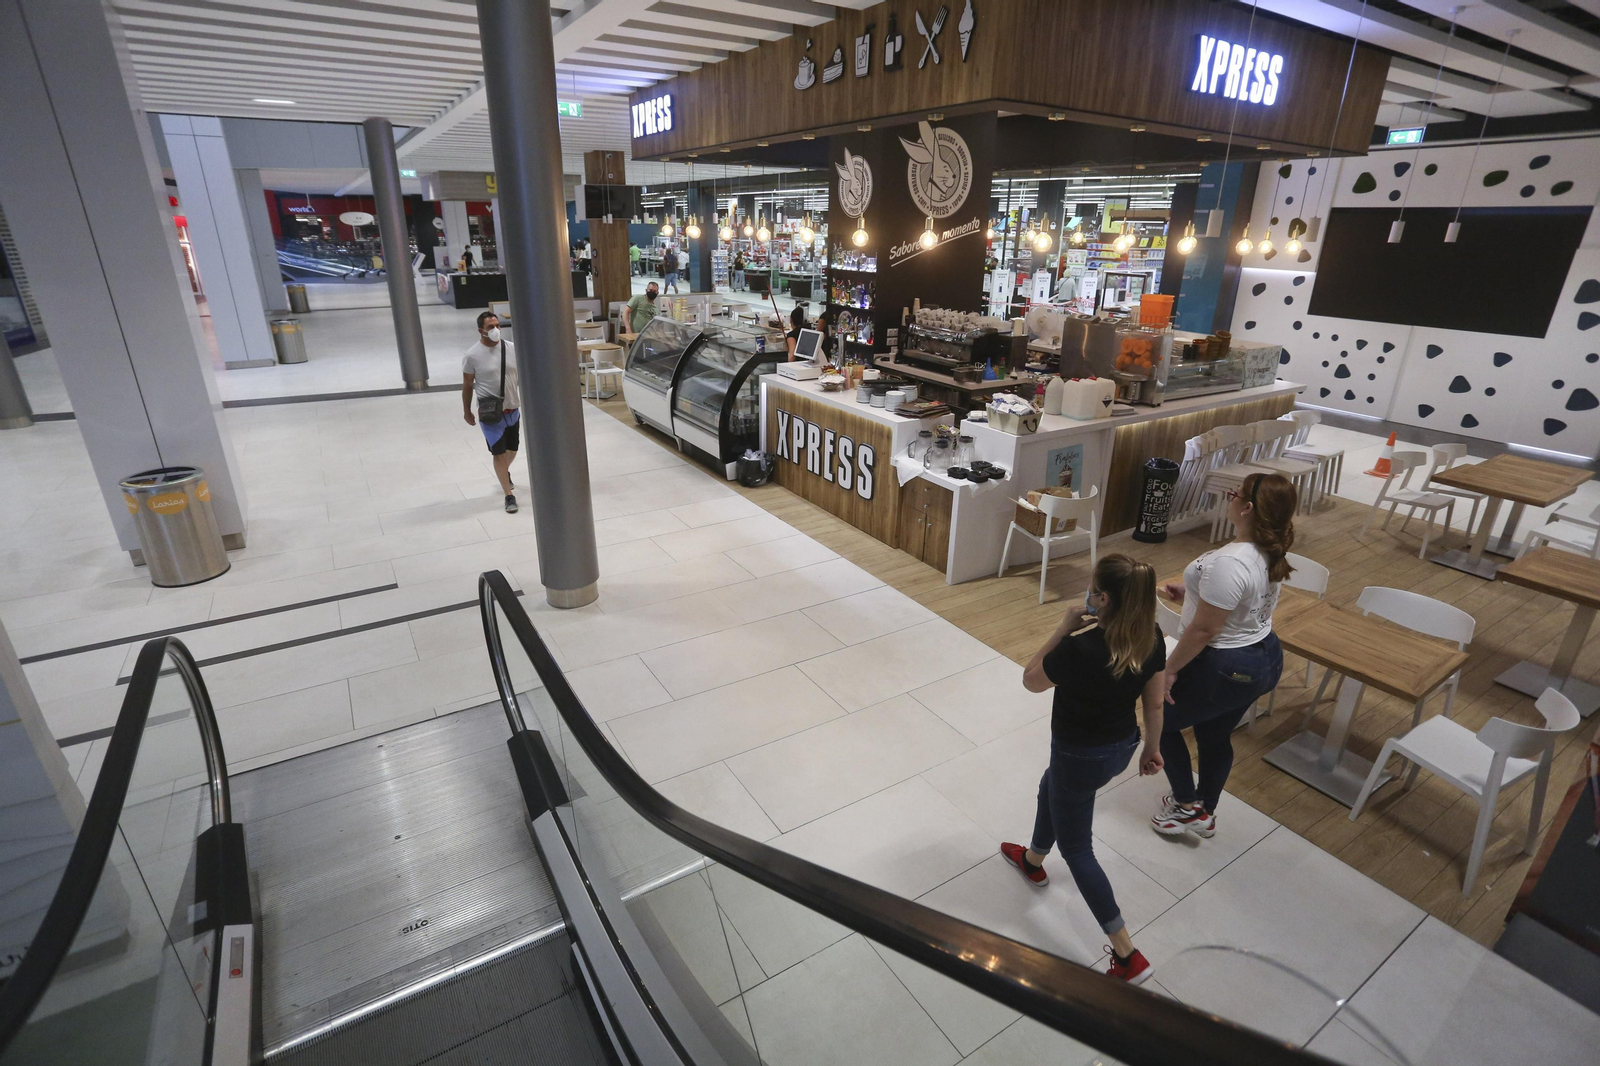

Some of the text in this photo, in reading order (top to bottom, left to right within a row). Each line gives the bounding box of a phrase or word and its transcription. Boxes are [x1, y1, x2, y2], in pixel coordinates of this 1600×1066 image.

[1191, 34, 1284, 106] XPRESS
[632, 94, 672, 139] XPRESS
[942, 217, 980, 241] momento
[776, 408, 875, 500] XPRESS
[152, 498, 185, 509] Larios
[402, 919, 429, 934] OTIS
